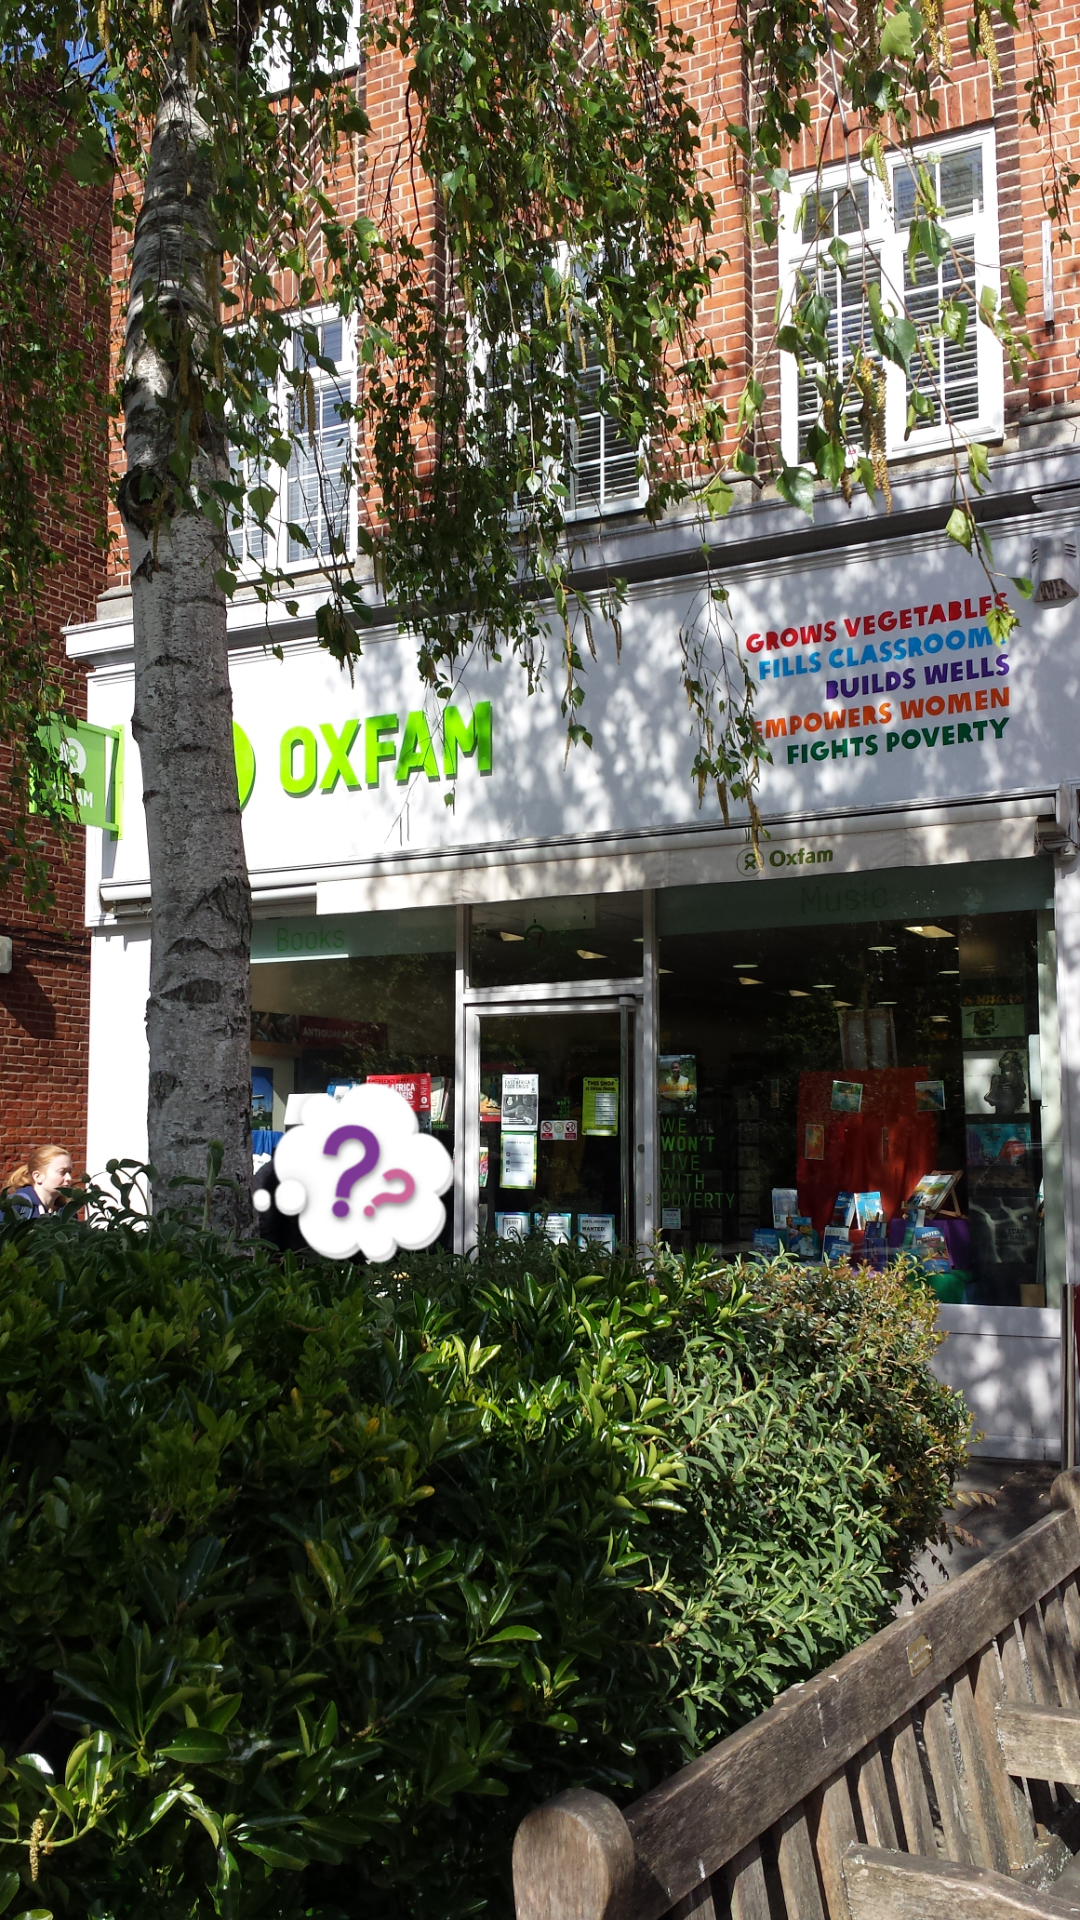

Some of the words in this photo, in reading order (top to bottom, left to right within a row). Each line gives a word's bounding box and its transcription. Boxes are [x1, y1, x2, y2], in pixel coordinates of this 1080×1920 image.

[745, 619, 838, 653] GROWS
[843, 592, 1008, 639] VEGETABLES
[758, 650, 822, 680] FILLS
[828, 626, 1007, 670] CLASSROOM
[826, 667, 916, 700] BUILDS
[924, 653, 1010, 685] WELLS
[900, 686, 1010, 720] WOMEN
[279, 700, 493, 796] OXFAM
[786, 733, 878, 765] FIGHTS
[886, 716, 1010, 753] POVERTY
[769, 847, 834, 868] Oxfam
[801, 883, 888, 914] Music
[276, 924, 345, 952] Books
[660, 1117, 687, 1134] WE
[660, 1136, 716, 1152] WON'T
[661, 1154, 700, 1171] LIVE
[660, 1173, 705, 1190] WITH
[661, 1191, 735, 1209] POVERTY
[921, 1229, 942, 1239] MOTEL
